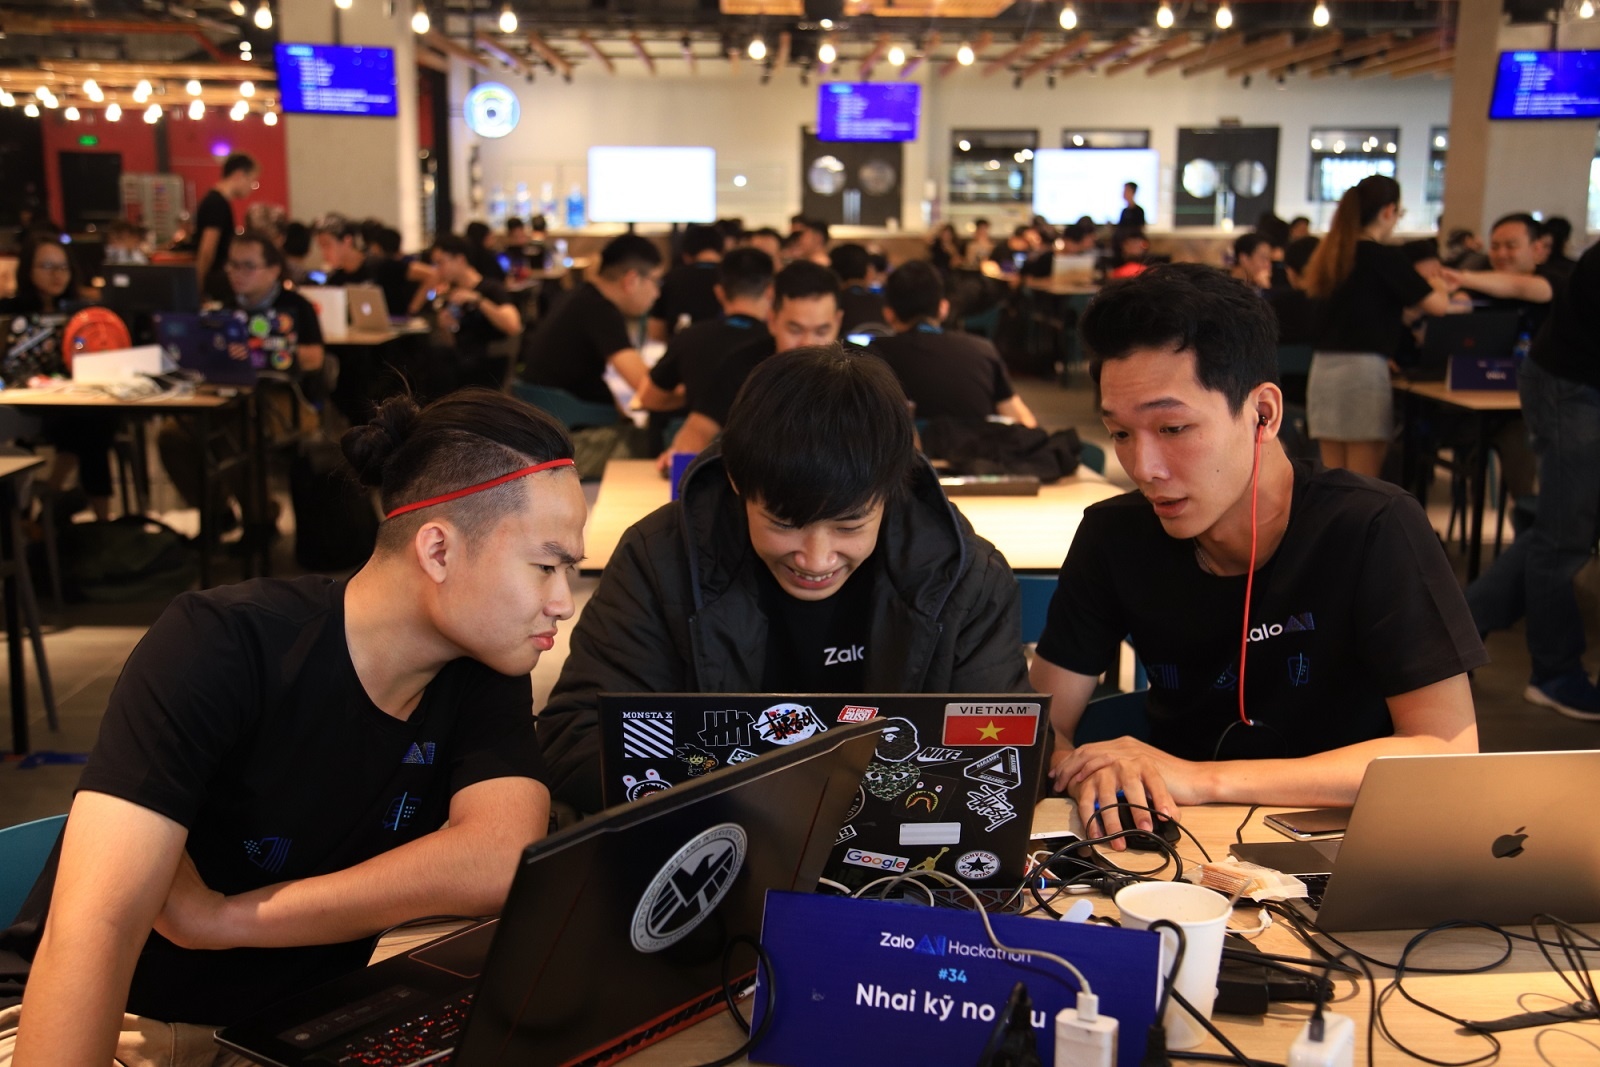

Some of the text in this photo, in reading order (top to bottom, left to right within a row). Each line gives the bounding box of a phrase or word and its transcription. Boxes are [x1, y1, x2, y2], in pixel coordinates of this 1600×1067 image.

[1246, 623, 1283, 642] alo
[622, 711, 673, 720] MONSTA X
[959, 706, 1028, 715] VIETNAM
[920, 747, 962, 761] NIKE
[846, 850, 906, 869] Google
[961, 852, 996, 862] CONVERSE
[879, 931, 915, 950] Zalo
[938, 967, 968, 984] #34
[855, 982, 917, 1013] Nhai
[923, 991, 955, 1022] kỹ
[961, 1001, 996, 1022] no
